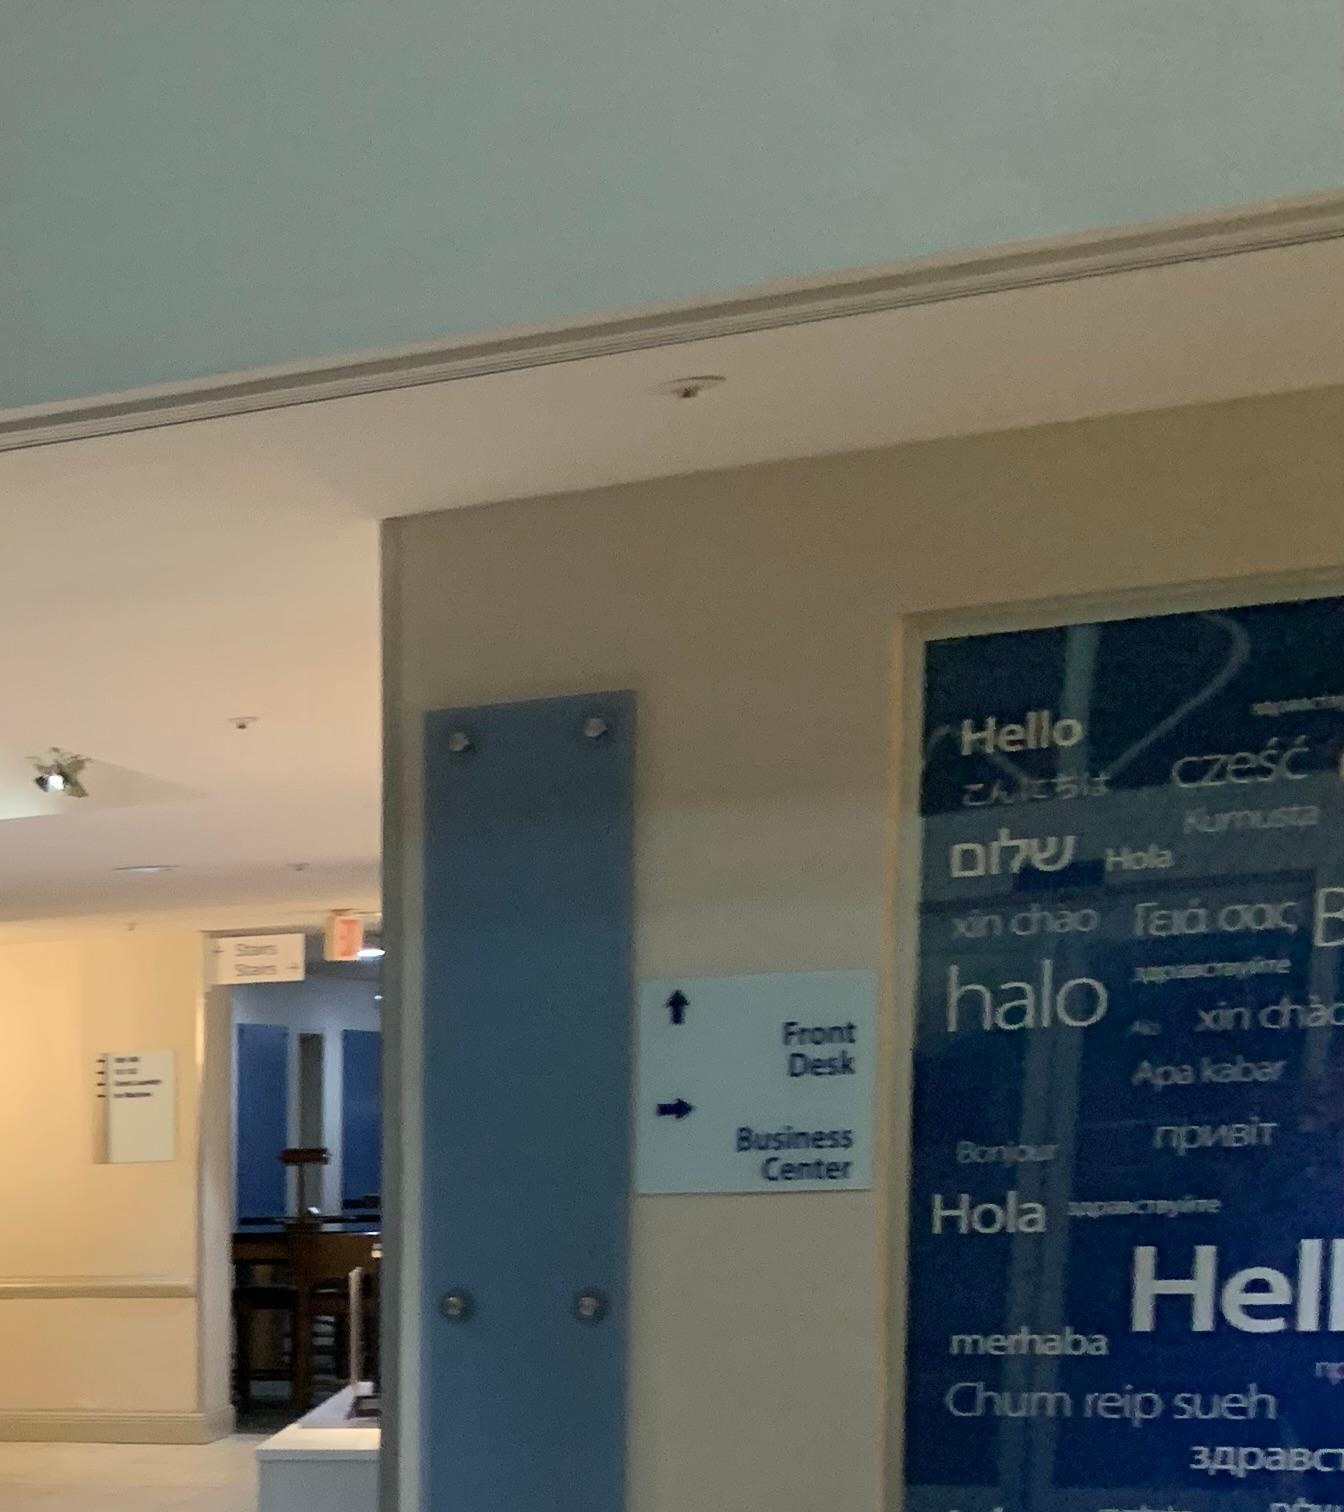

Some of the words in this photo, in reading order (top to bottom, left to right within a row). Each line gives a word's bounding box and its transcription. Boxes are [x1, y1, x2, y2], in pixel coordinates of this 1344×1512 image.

[959, 710, 1083, 756] Hello
[949, 828, 1076, 879] שלום
[1106, 845, 1174, 872] Hola
[945, 958, 1109, 1033] halo
[1193, 1001, 1250, 1032] xin
[783, 1021, 857, 1045] Front
[788, 1050, 856, 1077] Desk
[1131, 1060, 1195, 1091] Apa
[1201, 1055, 1287, 1083] kabar
[736, 1125, 854, 1152] Business
[763, 1157, 852, 1181] Center
[931, 1190, 1047, 1235] Hola
[949, 1326, 1110, 1356] merhaba
[944, 1382, 1072, 1418] Chum
[1083, 1384, 1164, 1428] reip
[1173, 1382, 1277, 1420] sueh
